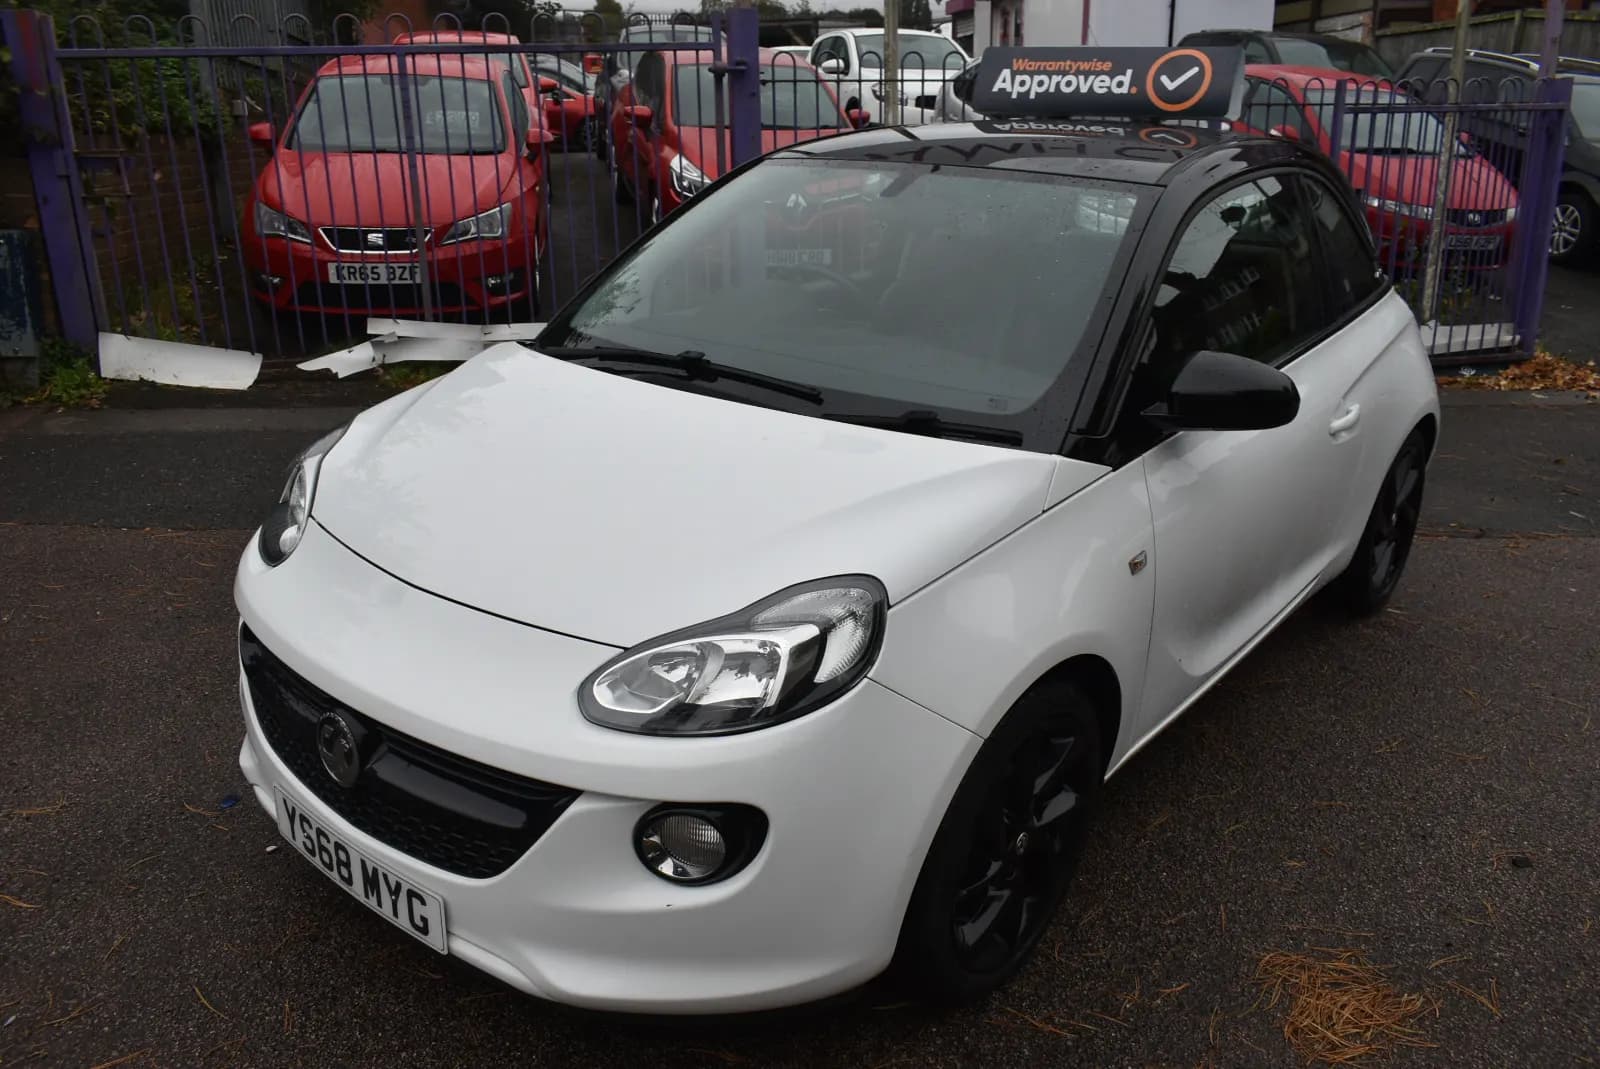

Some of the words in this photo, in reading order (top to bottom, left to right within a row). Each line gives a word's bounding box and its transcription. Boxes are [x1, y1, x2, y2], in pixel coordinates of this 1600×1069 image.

[1012, 58, 1112, 73] Warrantywise
[992, 69, 1137, 99] Approved.
[335, 265, 380, 281] KR65
[282, 797, 353, 887] YS68
[360, 857, 429, 936] MYG
